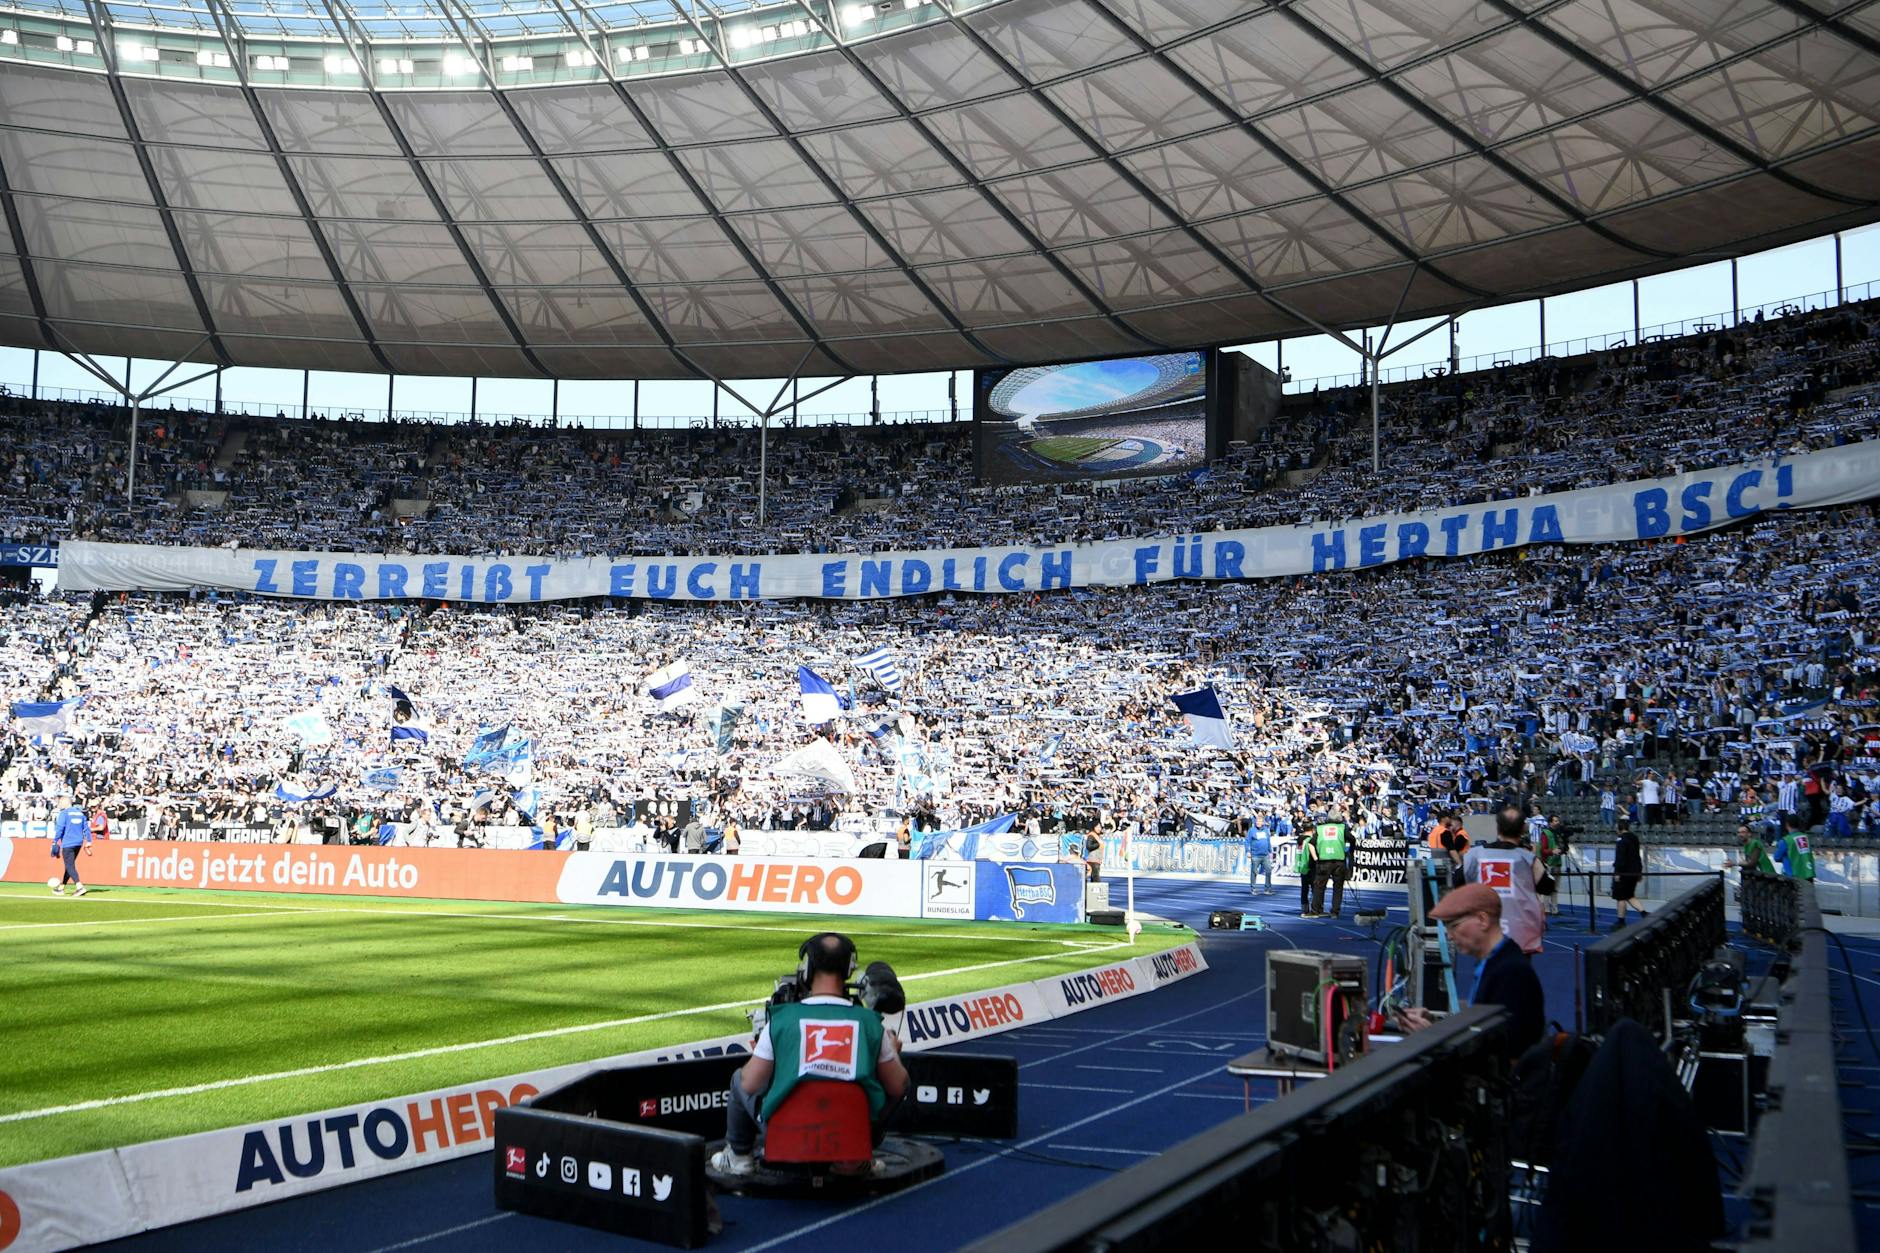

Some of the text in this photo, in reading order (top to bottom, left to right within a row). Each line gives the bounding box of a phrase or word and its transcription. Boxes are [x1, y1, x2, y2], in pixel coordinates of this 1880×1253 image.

[608, 562, 761, 599] EUCH
[822, 550, 1072, 597] ENDLICH
[1134, 536, 1246, 584] FÜR
[1311, 503, 1565, 573] HERTHA
[1633, 464, 1793, 539] BSC!
[185, 828, 271, 844] HOIGANS
[1362, 840, 1395, 848] GEDENKEN
[1395, 840, 1406, 848] AN
[120, 848, 418, 889] Finde jetzt dein Auto
[1353, 850, 1406, 866] HERMANN
[597, 860, 863, 905] AUTOHERO
[1351, 866, 1405, 884] HORWITZ
[927, 906, 970, 914] BUNDESLIGA
[1152, 948, 1197, 980] AUTOHERO
[1061, 967, 1134, 1007] AUTOHERO
[907, 993, 1023, 1043] AUTOHERO
